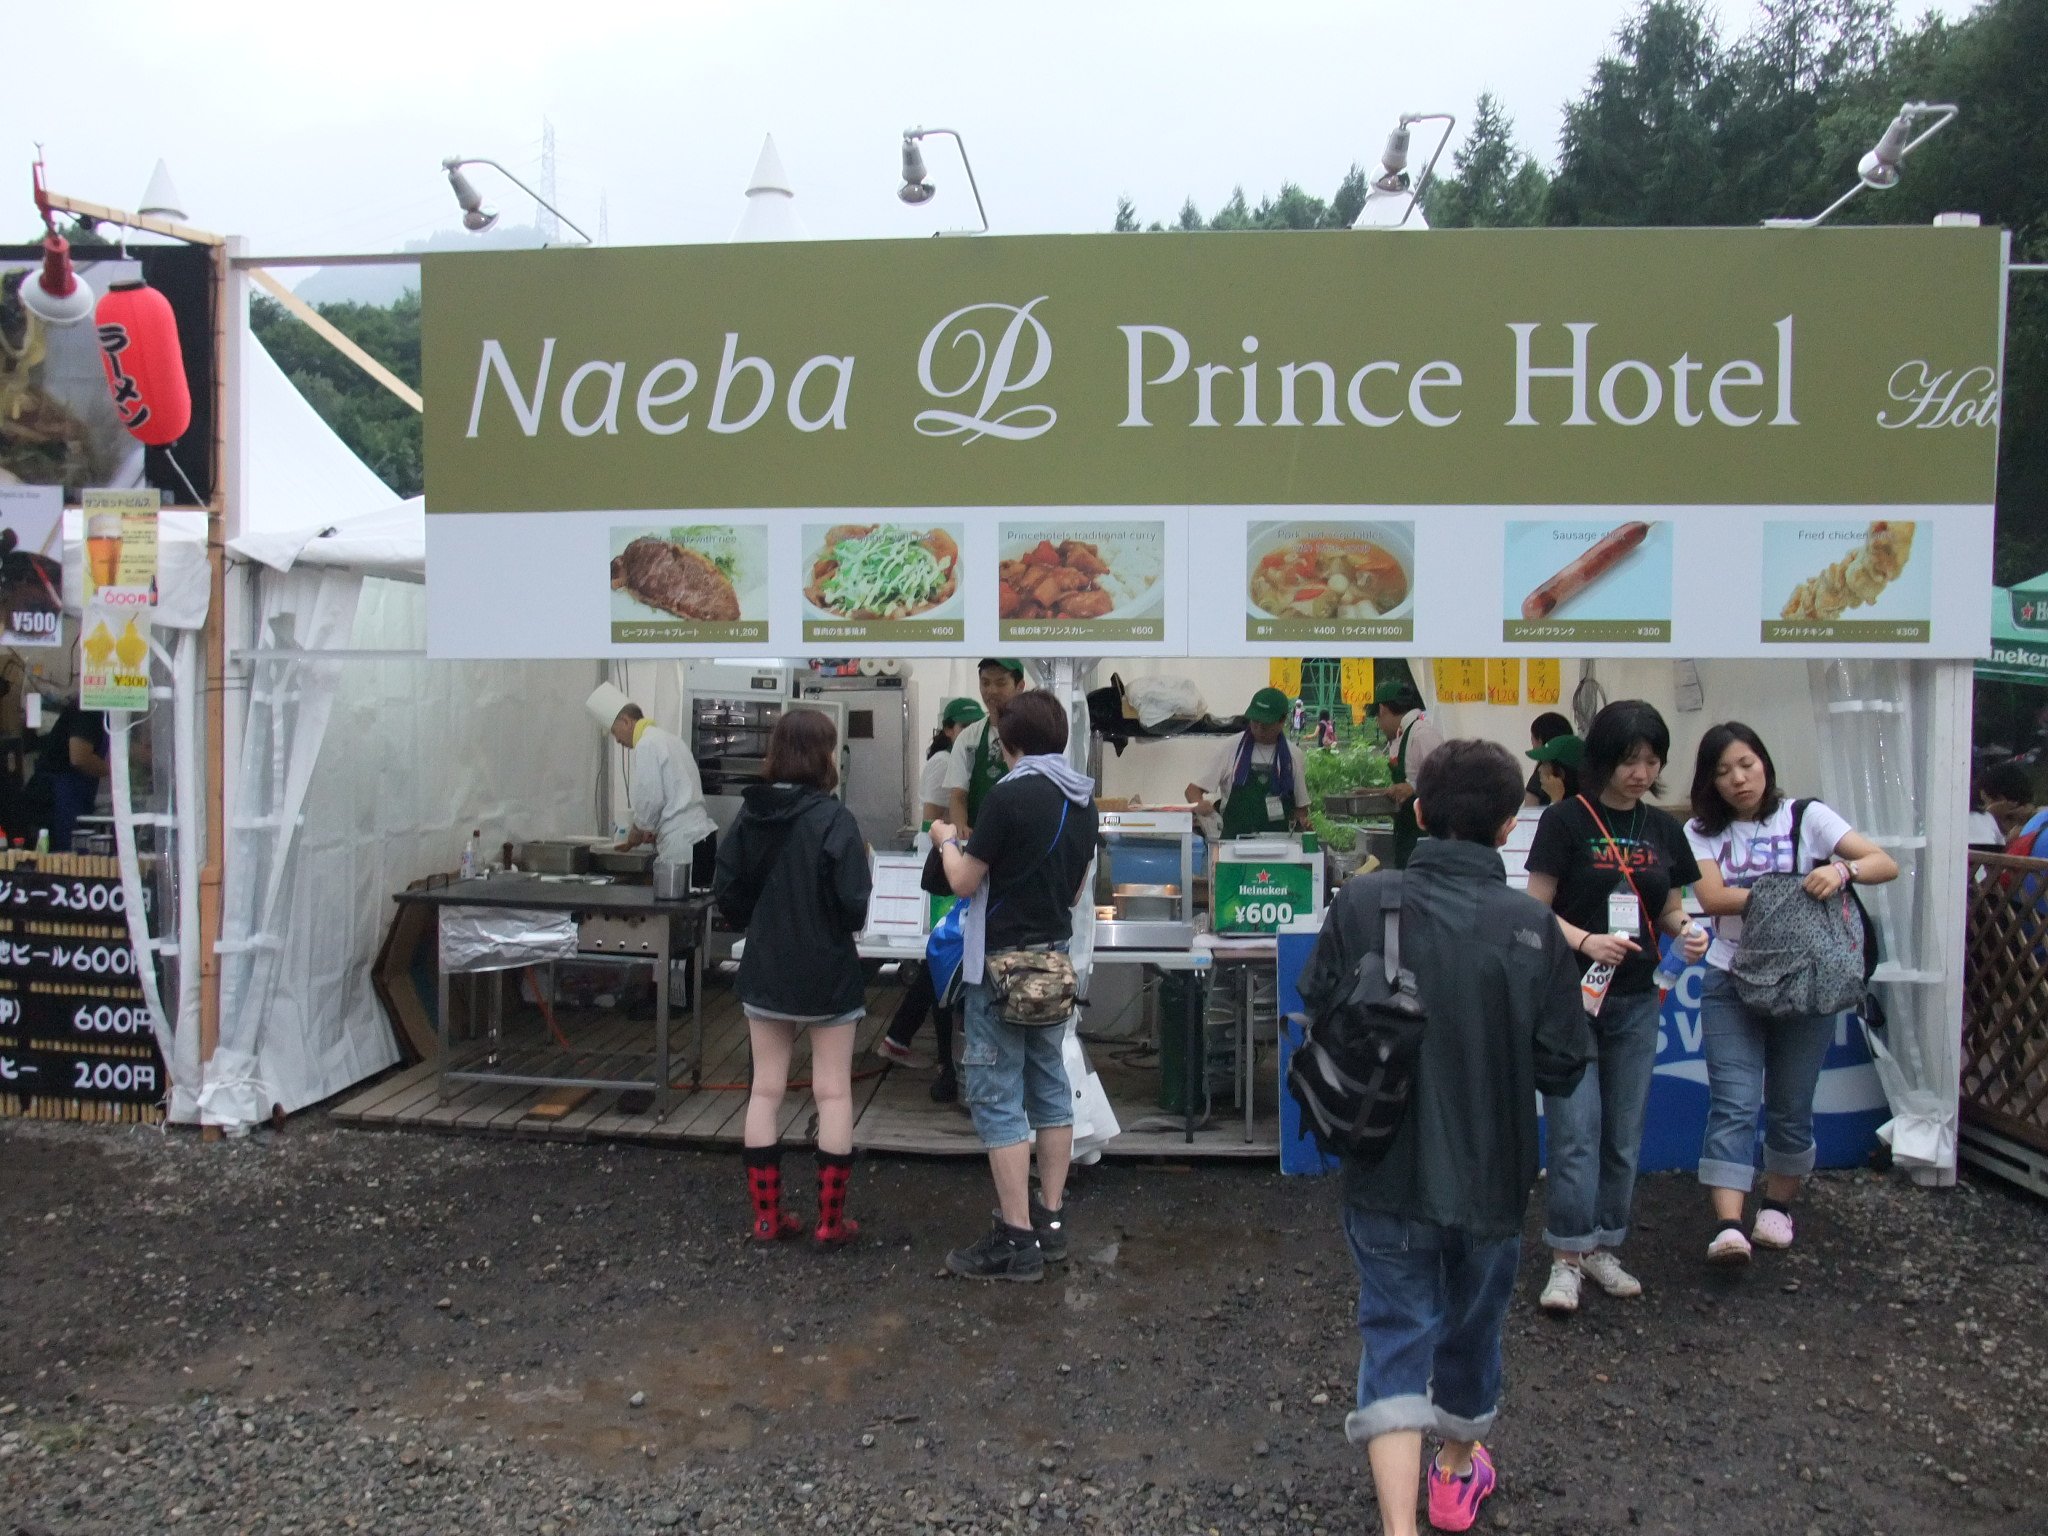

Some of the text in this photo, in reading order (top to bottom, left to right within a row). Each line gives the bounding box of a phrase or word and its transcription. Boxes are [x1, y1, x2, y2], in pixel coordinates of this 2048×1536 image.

[97, 322, 151, 429] ラーメン
[466, 332, 856, 438] Naeba
[1117, 324, 1463, 429] Prince
[1504, 313, 1801, 428] Hotel
[1074, 530, 1126, 540] traditional
[1130, 532, 1156, 542] curry
[1552, 530, 1597, 542] Sausage
[1798, 530, 1825, 540] Fried
[1828, 530, 1870, 540] chicken
[12, 610, 56, 632] ¥500
[729, 627, 759, 637] ¥1,200
[932, 627, 954, 636] ¥600
[1131, 625, 1154, 636] ¥600
[1314, 626, 1336, 636] ¥400
[1637, 627, 1660, 637] ¥300
[1896, 627, 1919, 637] ¥300
[1991, 647, 2048, 668] neken
[1238, 885, 1288, 896] Heineken
[1234, 902, 1293, 924] ¥600
[74, 1004, 155, 1035] 600円
[74, 1061, 156, 1092] 200円
